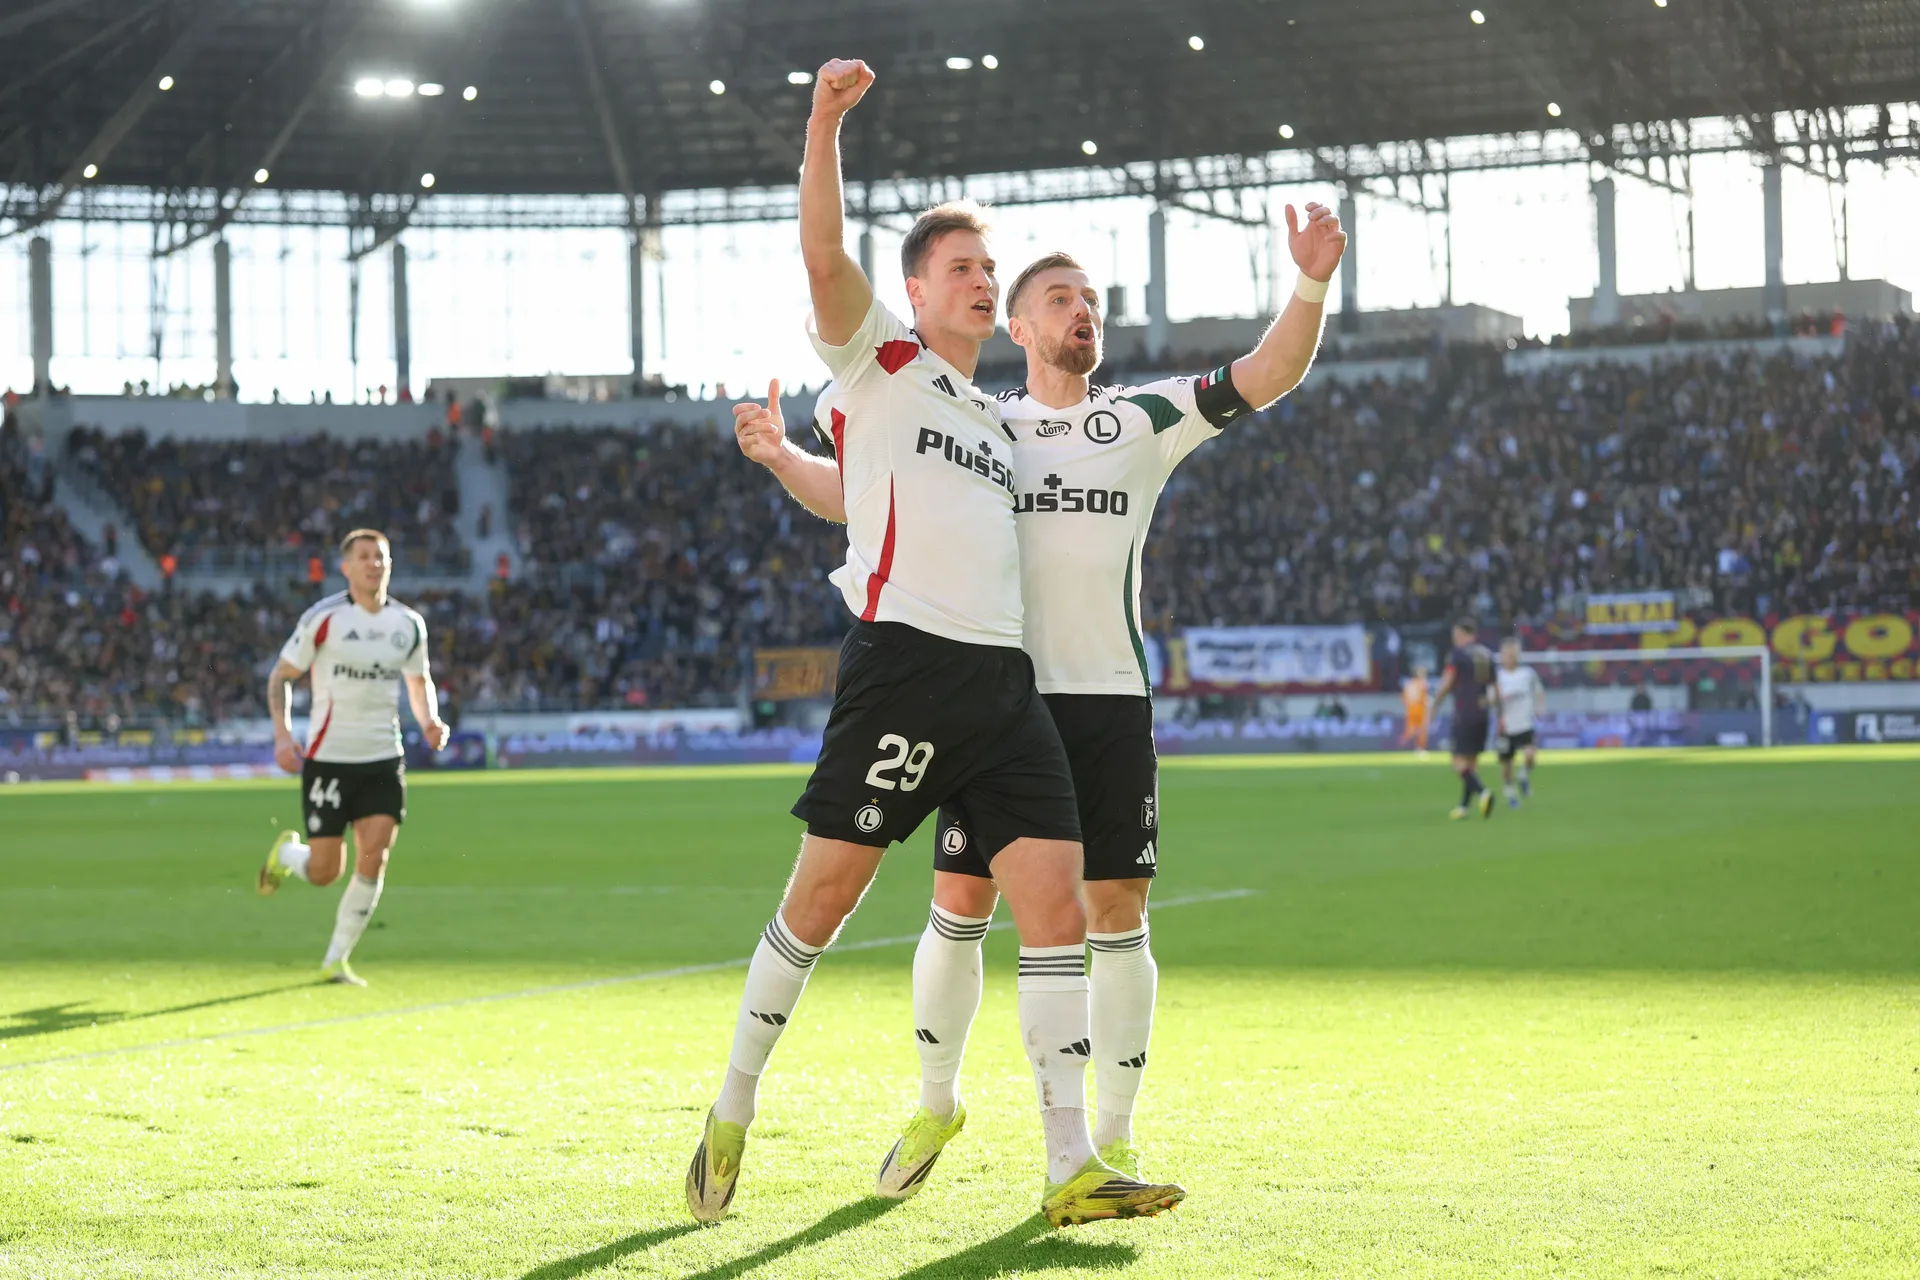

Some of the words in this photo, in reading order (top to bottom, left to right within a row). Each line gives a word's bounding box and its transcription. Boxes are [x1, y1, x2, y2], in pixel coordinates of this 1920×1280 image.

[1043, 424, 1066, 435] LOTTO
[916, 427, 1015, 494] Plus50
[1012, 487, 1129, 517] us500
[865, 733, 935, 792] 29
[308, 776, 342, 810] 44
